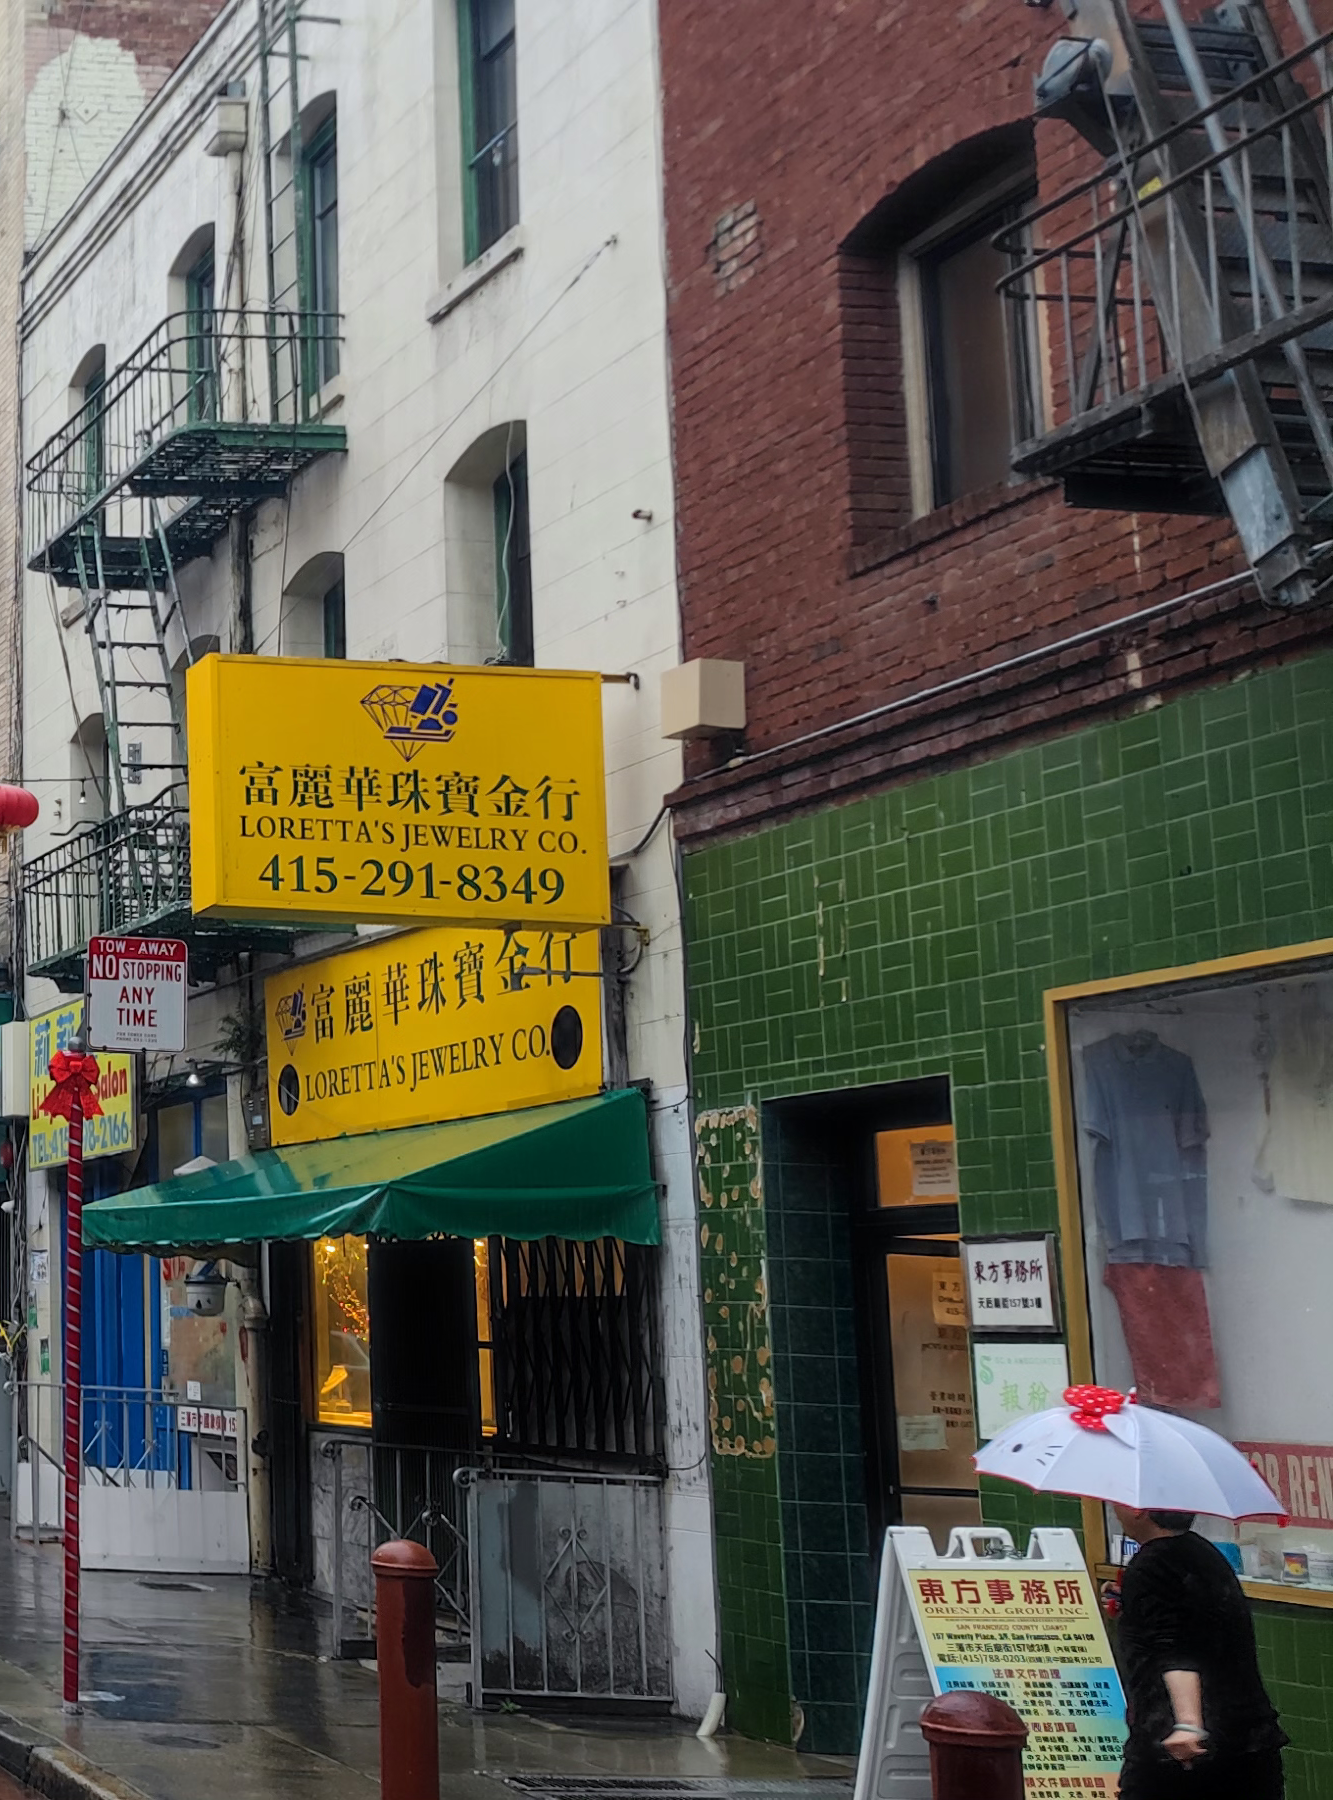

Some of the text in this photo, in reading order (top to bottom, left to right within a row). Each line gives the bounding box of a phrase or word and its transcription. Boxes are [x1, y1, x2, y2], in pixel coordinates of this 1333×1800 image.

[239, 761, 580, 822] 富麗華珠寶金行
[240, 815, 587, 855] LORETTA'S JEWELRY CO.
[258, 854, 564, 905] 415-291-8349
[92, 954, 182, 983] NO STOPPING
[119, 986, 155, 1005] ANY
[311, 930, 577, 1045] 富麗華珠寶金行
[117, 1007, 157, 1027] TIME
[305, 1024, 551, 1102] LORETTA'S JEWELRY CO.
[974, 1258, 1043, 1284] 東方事務所
[1287, 1454, 1333, 1519] REN
[917, 1578, 1083, 1605] 東方事務所
[925, 1607, 1089, 1616] ORIENTAL GROUP INC.
[946, 1633, 974, 1641] Waverly
[1011, 1633, 1025, 1641] San
